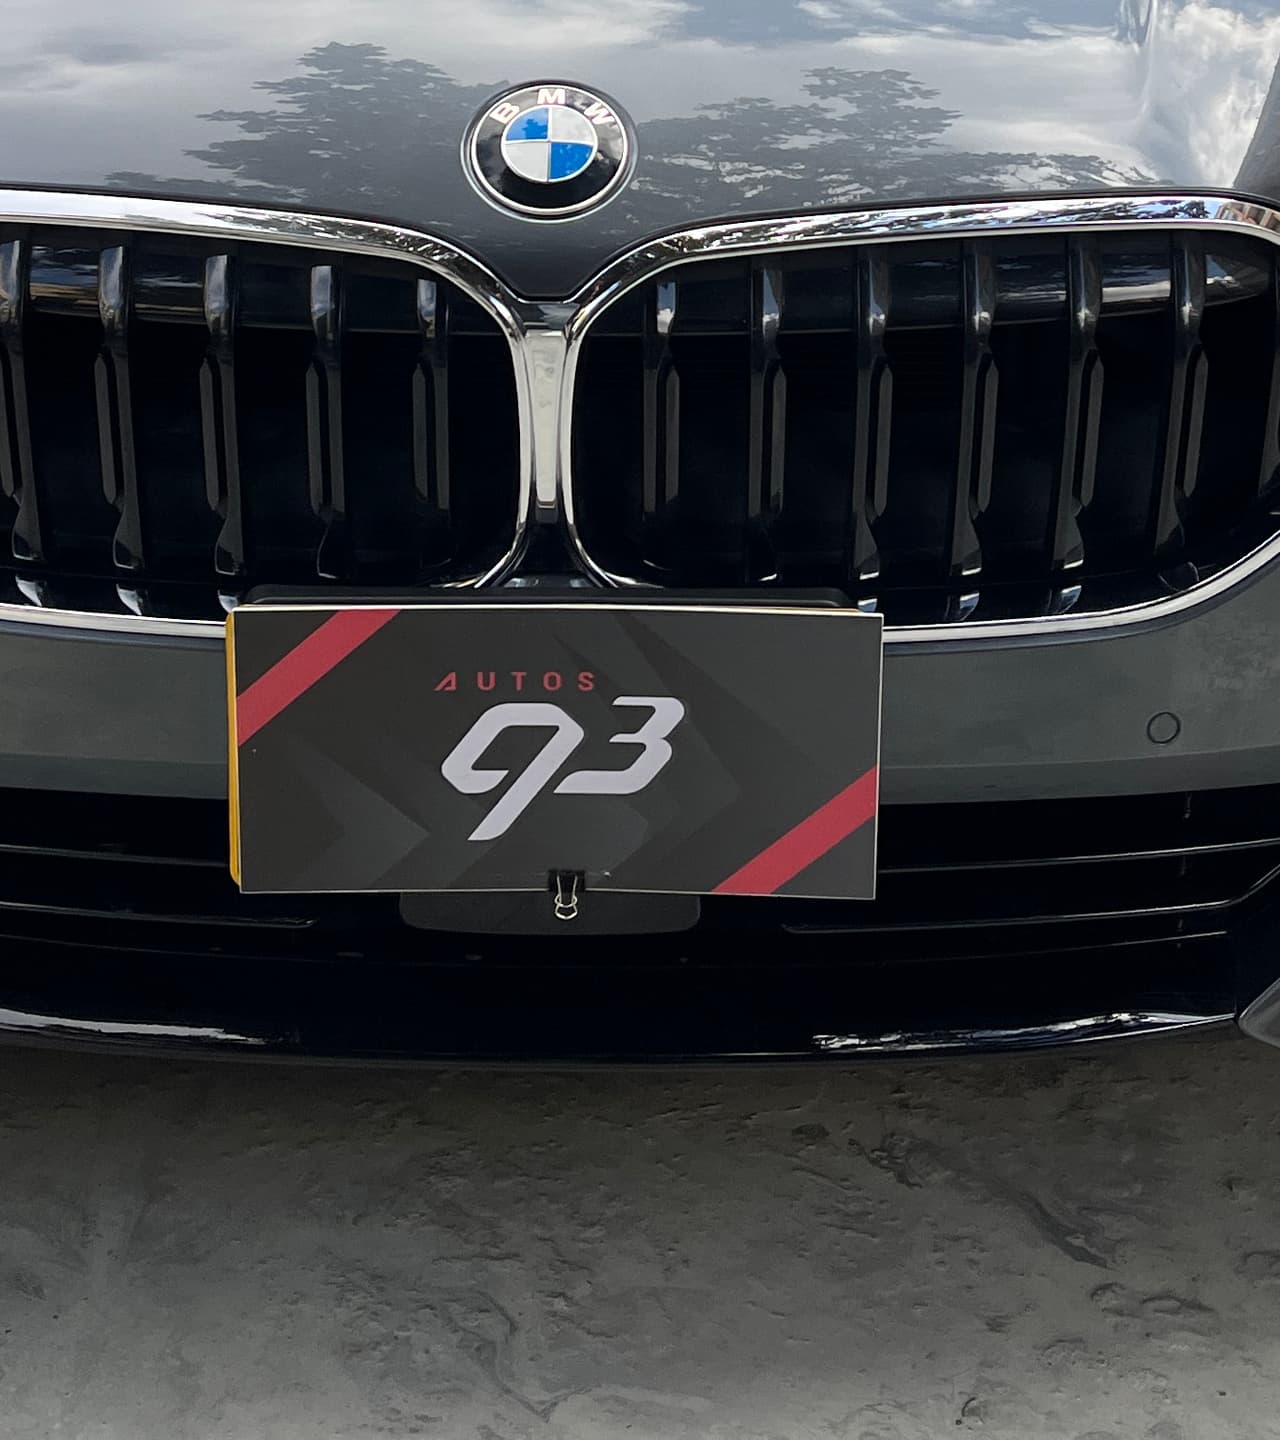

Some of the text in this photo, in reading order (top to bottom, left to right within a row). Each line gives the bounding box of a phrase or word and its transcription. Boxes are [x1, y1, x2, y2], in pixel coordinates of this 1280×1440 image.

[489, 88, 615, 125] BMW
[434, 671, 596, 692] AUTOS
[441, 696, 686, 841] 93
